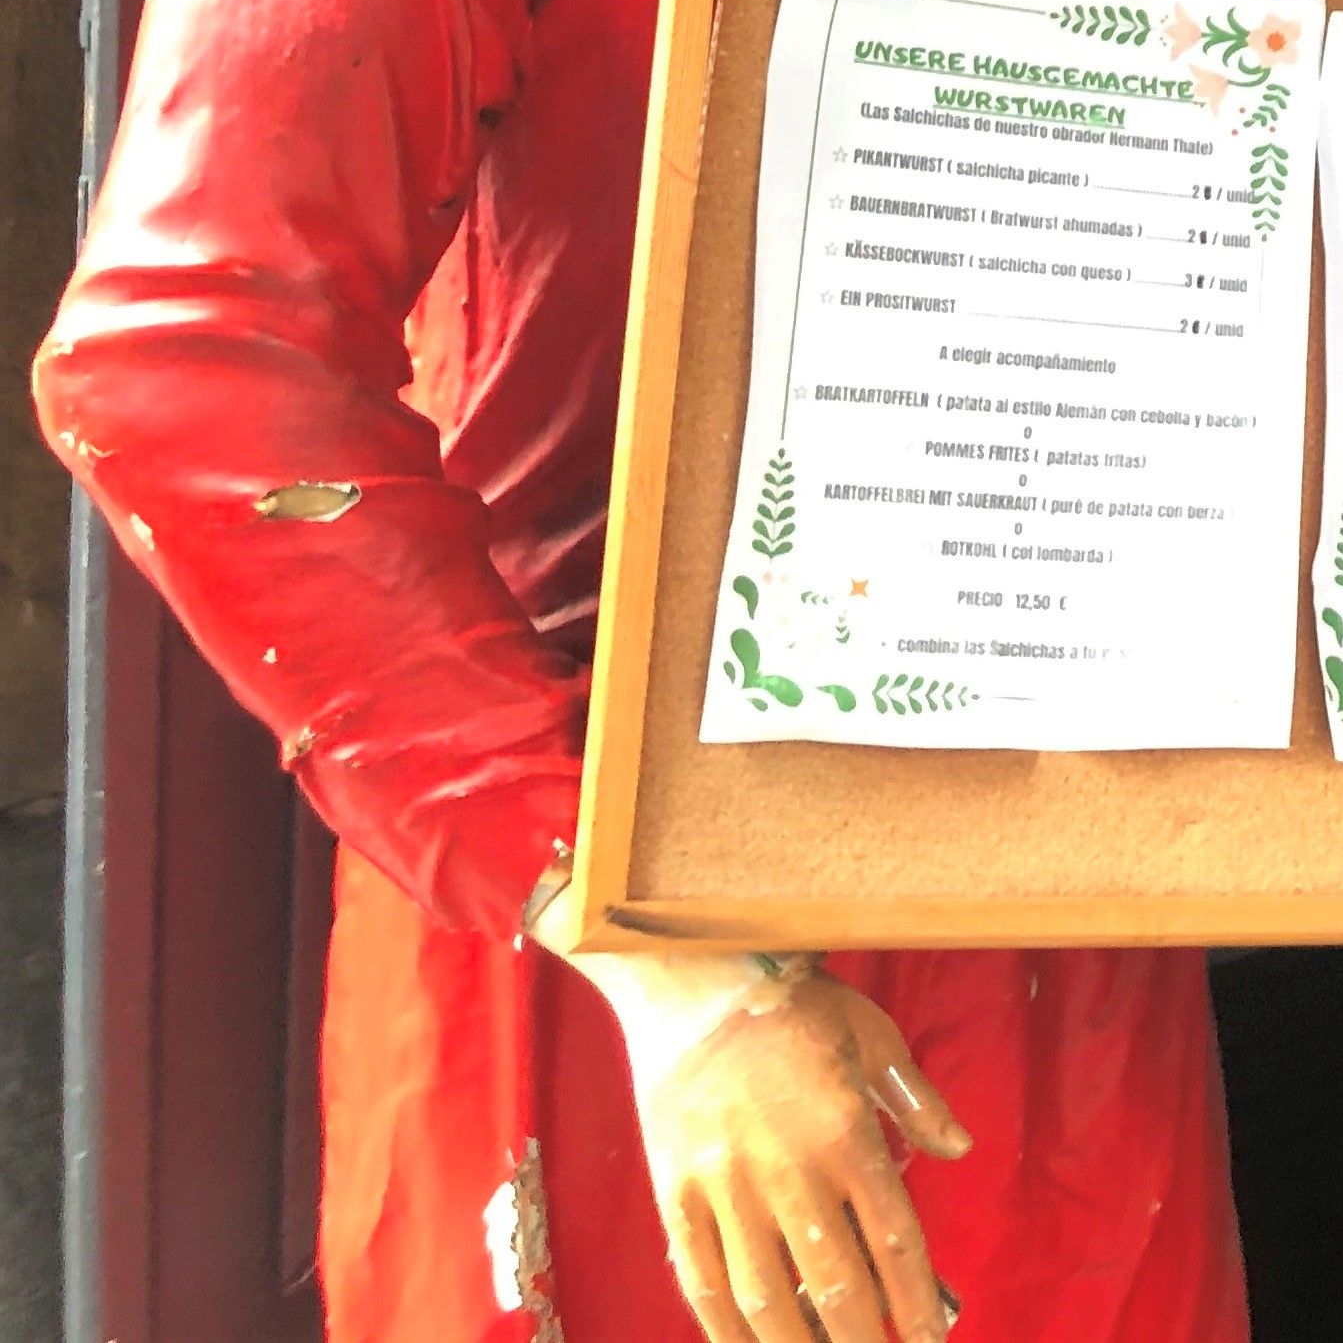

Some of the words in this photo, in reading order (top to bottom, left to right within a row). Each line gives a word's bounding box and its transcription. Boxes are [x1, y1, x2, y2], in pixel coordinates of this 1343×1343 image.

[854, 40, 966, 73] UNSERE
[973, 54, 1195, 100] HAUSGEMACHTE
[934, 86, 1126, 126] WURSTWAREN
[894, 106, 970, 131] Salchichas
[974, 115, 991, 132] de
[995, 119, 1048, 139] nuestro
[1052, 125, 1106, 146] obrador
[1110, 131, 1169, 152] Hermann
[853, 148, 944, 174] PIKANTWURST
[956, 160, 1025, 182] salchicha
[1028, 167, 1080, 187] picante
[850, 195, 977, 223] BAUERNBRATWURST
[991, 210, 1059, 231] Bratwurst
[1063, 217, 1133, 238] ahumadas
[845, 239, 965, 268] KÄSSEBOCKWURST
[978, 255, 1047, 276] salchicha
[1052, 262, 1077, 277] con
[1081, 265, 1123, 282] queso
[840, 289, 862, 307] EIN
[865, 292, 956, 314] PROSITWURST
[939, 345, 948, 360] A
[952, 346, 992, 365] elegir
[996, 350, 1117, 375] acompañamiento
[815, 384, 929, 408] BRATKARTOFFELN
[946, 394, 992, 412] patata
[1012, 399, 1052, 417] estilo
[1056, 402, 1107, 420] Alemán
[1111, 407, 1136, 423] con
[1140, 409, 1190, 426] cebolla
[925, 440, 985, 460] POMMES
[988, 445, 1030, 463] FRITES
[1047, 451, 1099, 467] patatas
[824, 483, 925, 505] KARTOFFELBREI
[929, 489, 952, 506] MIT
[957, 492, 1038, 512] SAUERKRAUT
[1086, 500, 1103, 515] de
[1109, 502, 1153, 518] patata
[1157, 505, 1182, 519] con
[941, 539, 997, 559] ROTKOHL
[1011, 546, 1033, 561] col
[1037, 546, 1104, 564] lombarda
[957, 590, 1003, 607] PRECIO
[1016, 593, 1050, 610] 12,50
[897, 638, 960, 655] combina
[964, 640, 985, 656] las
[990, 639, 1065, 660] Salchichas
